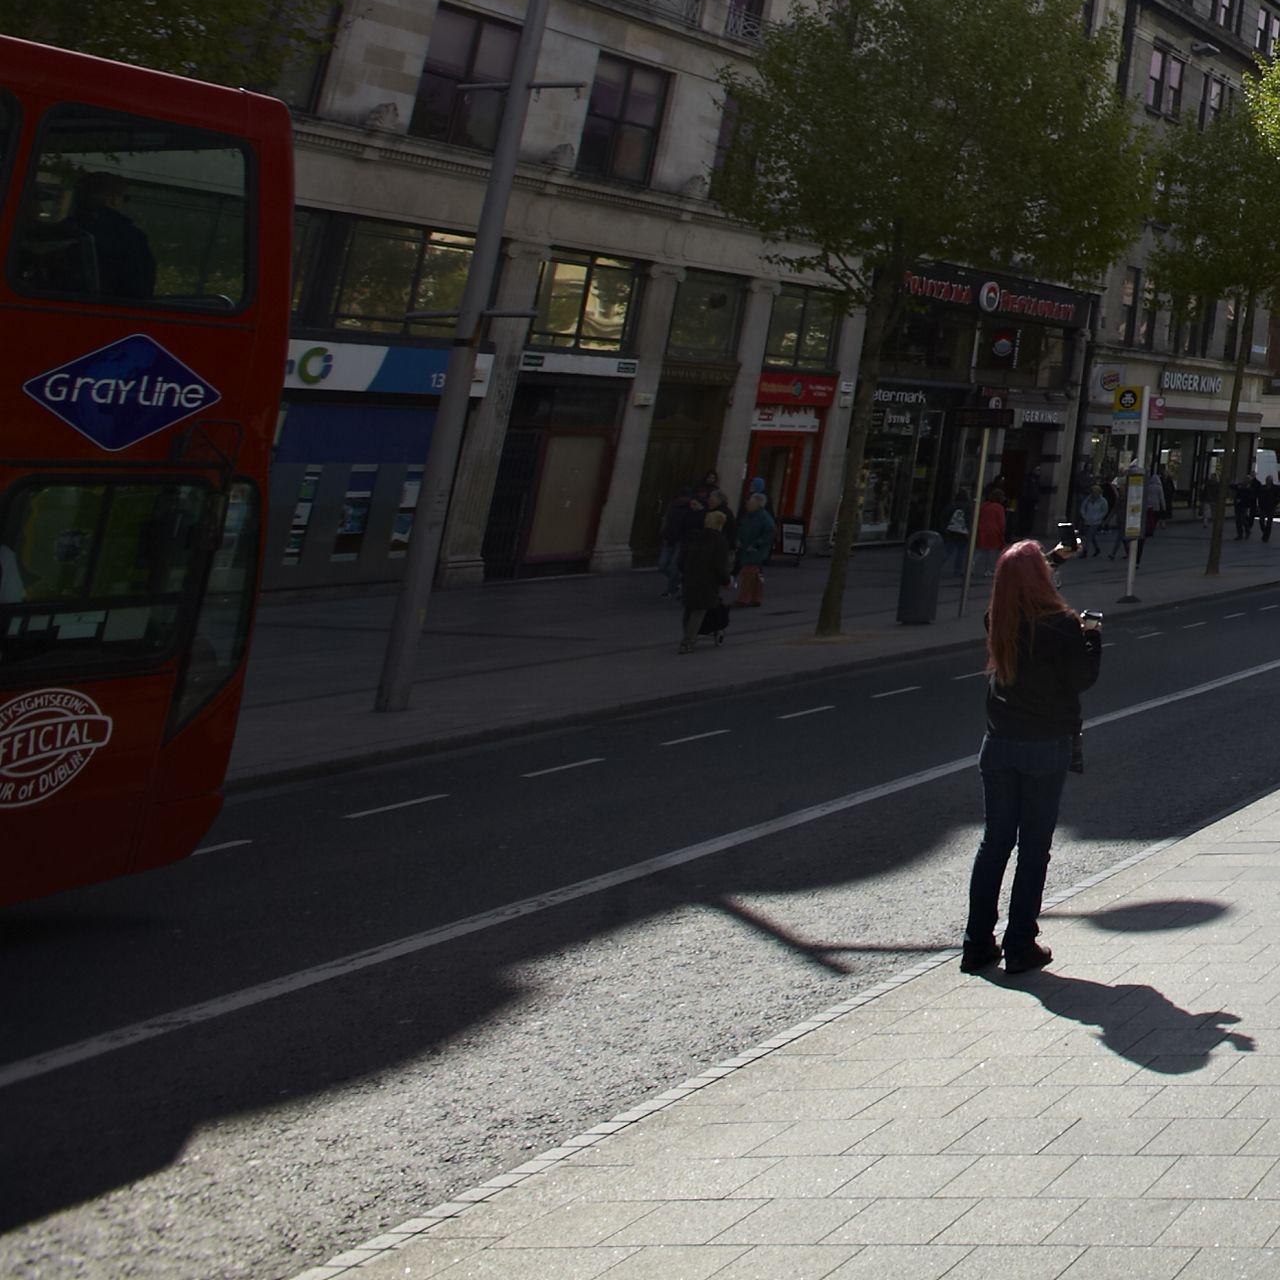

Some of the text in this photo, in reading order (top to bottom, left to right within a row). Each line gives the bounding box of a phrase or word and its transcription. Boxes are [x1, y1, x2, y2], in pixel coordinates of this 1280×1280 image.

[873, 388, 896, 402] eter
[1163, 371, 1223, 393] BURGER KING
[0, 722, 94, 766] FFICIAL
[18, 780, 37, 800] of
[39, 751, 84, 794] DUBLIN
